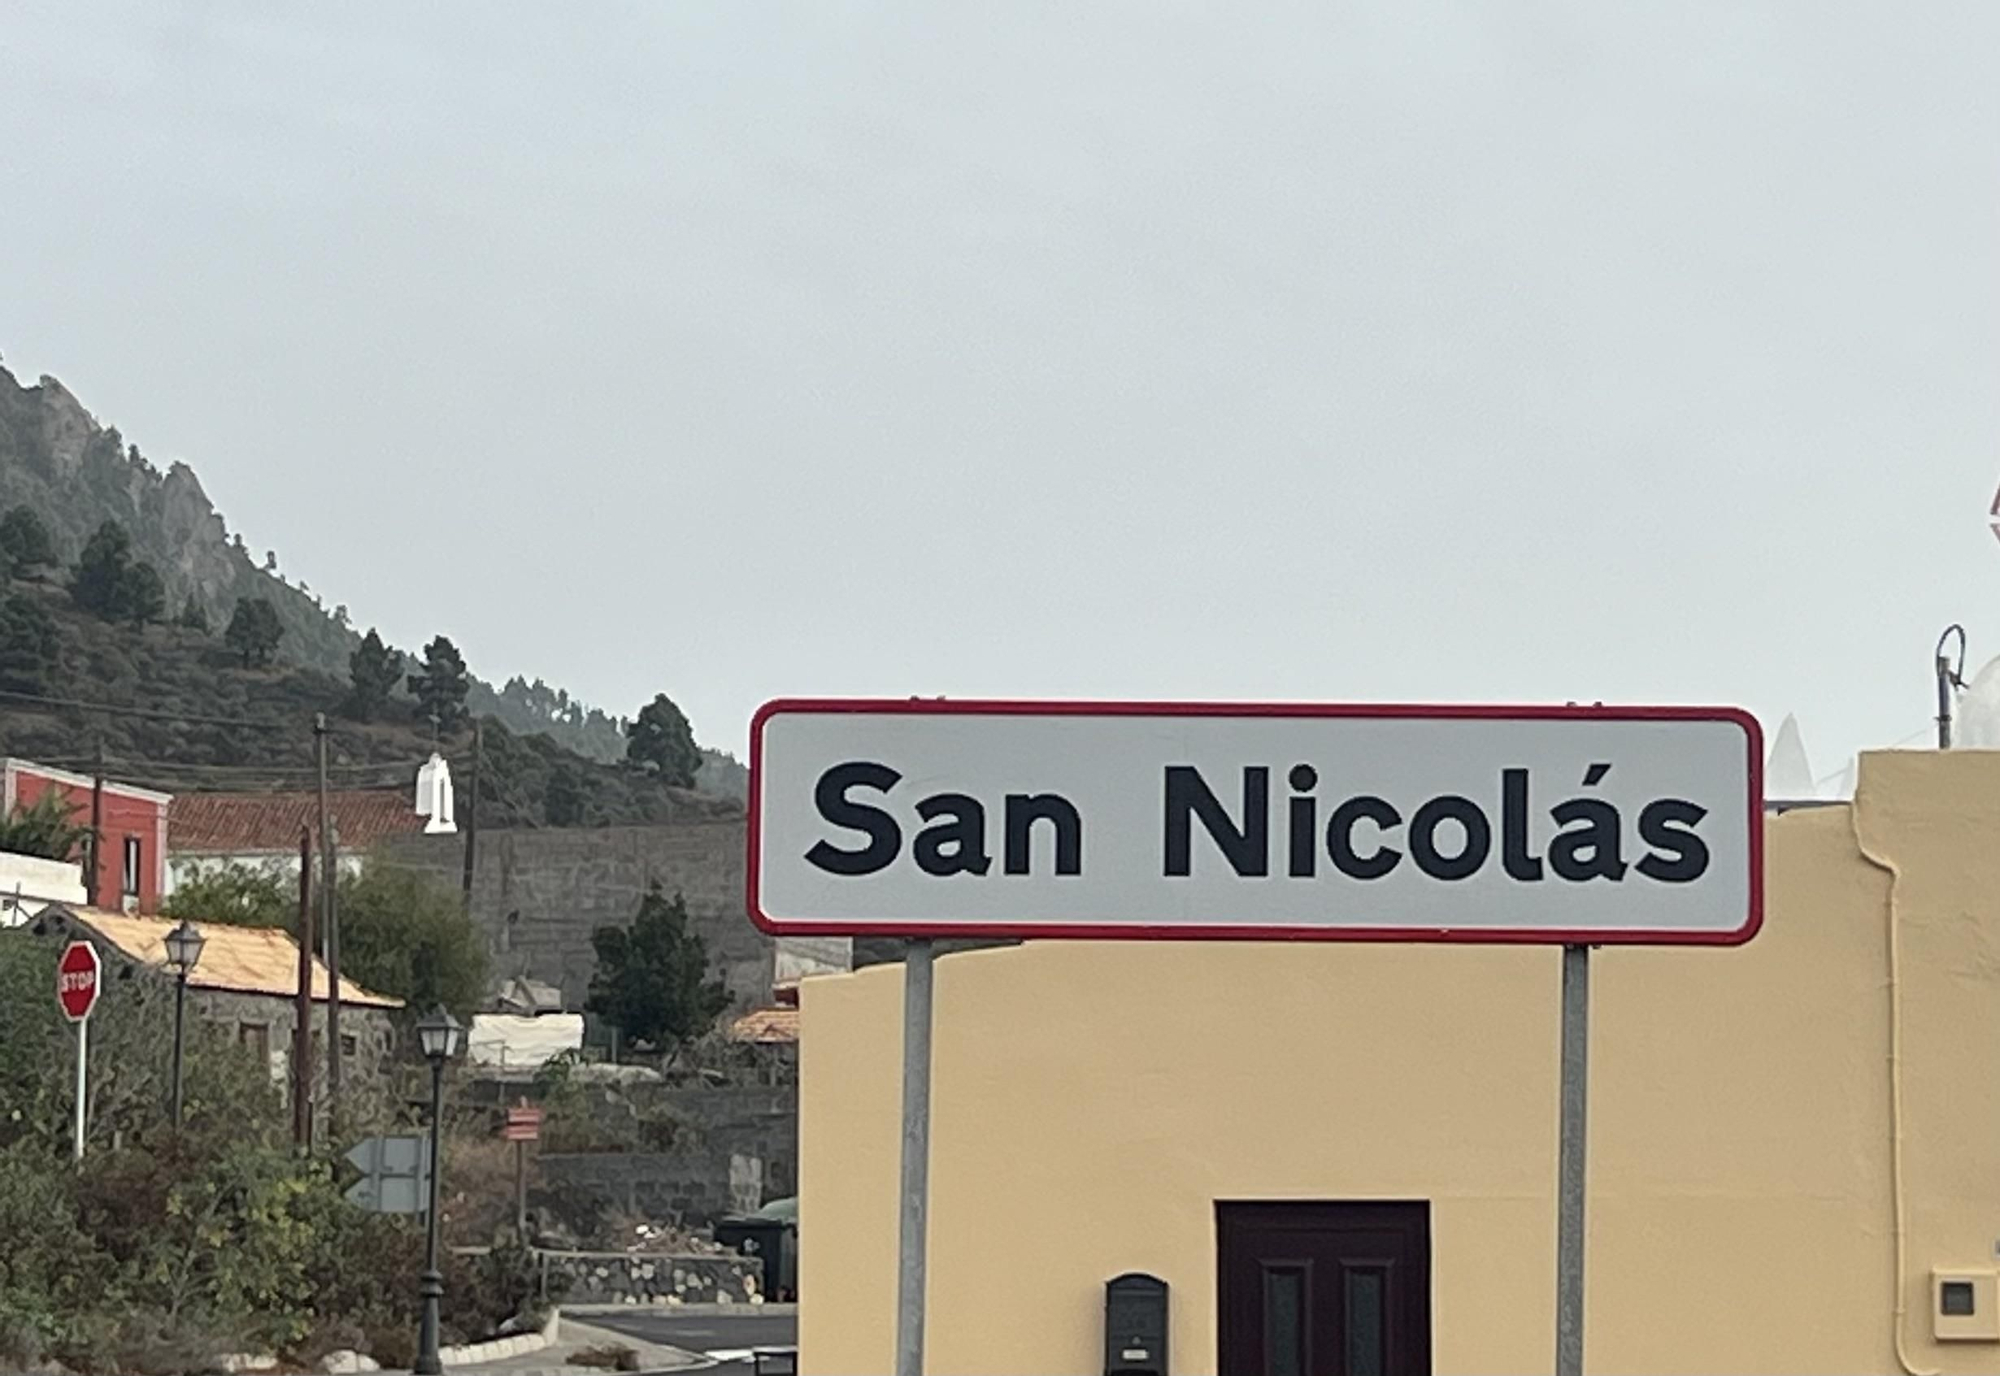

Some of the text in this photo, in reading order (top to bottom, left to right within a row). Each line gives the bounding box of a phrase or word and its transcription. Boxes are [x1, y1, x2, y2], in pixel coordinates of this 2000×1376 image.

[803, 761, 1710, 884] San Nicolás
[61, 971, 95, 993] STOP
